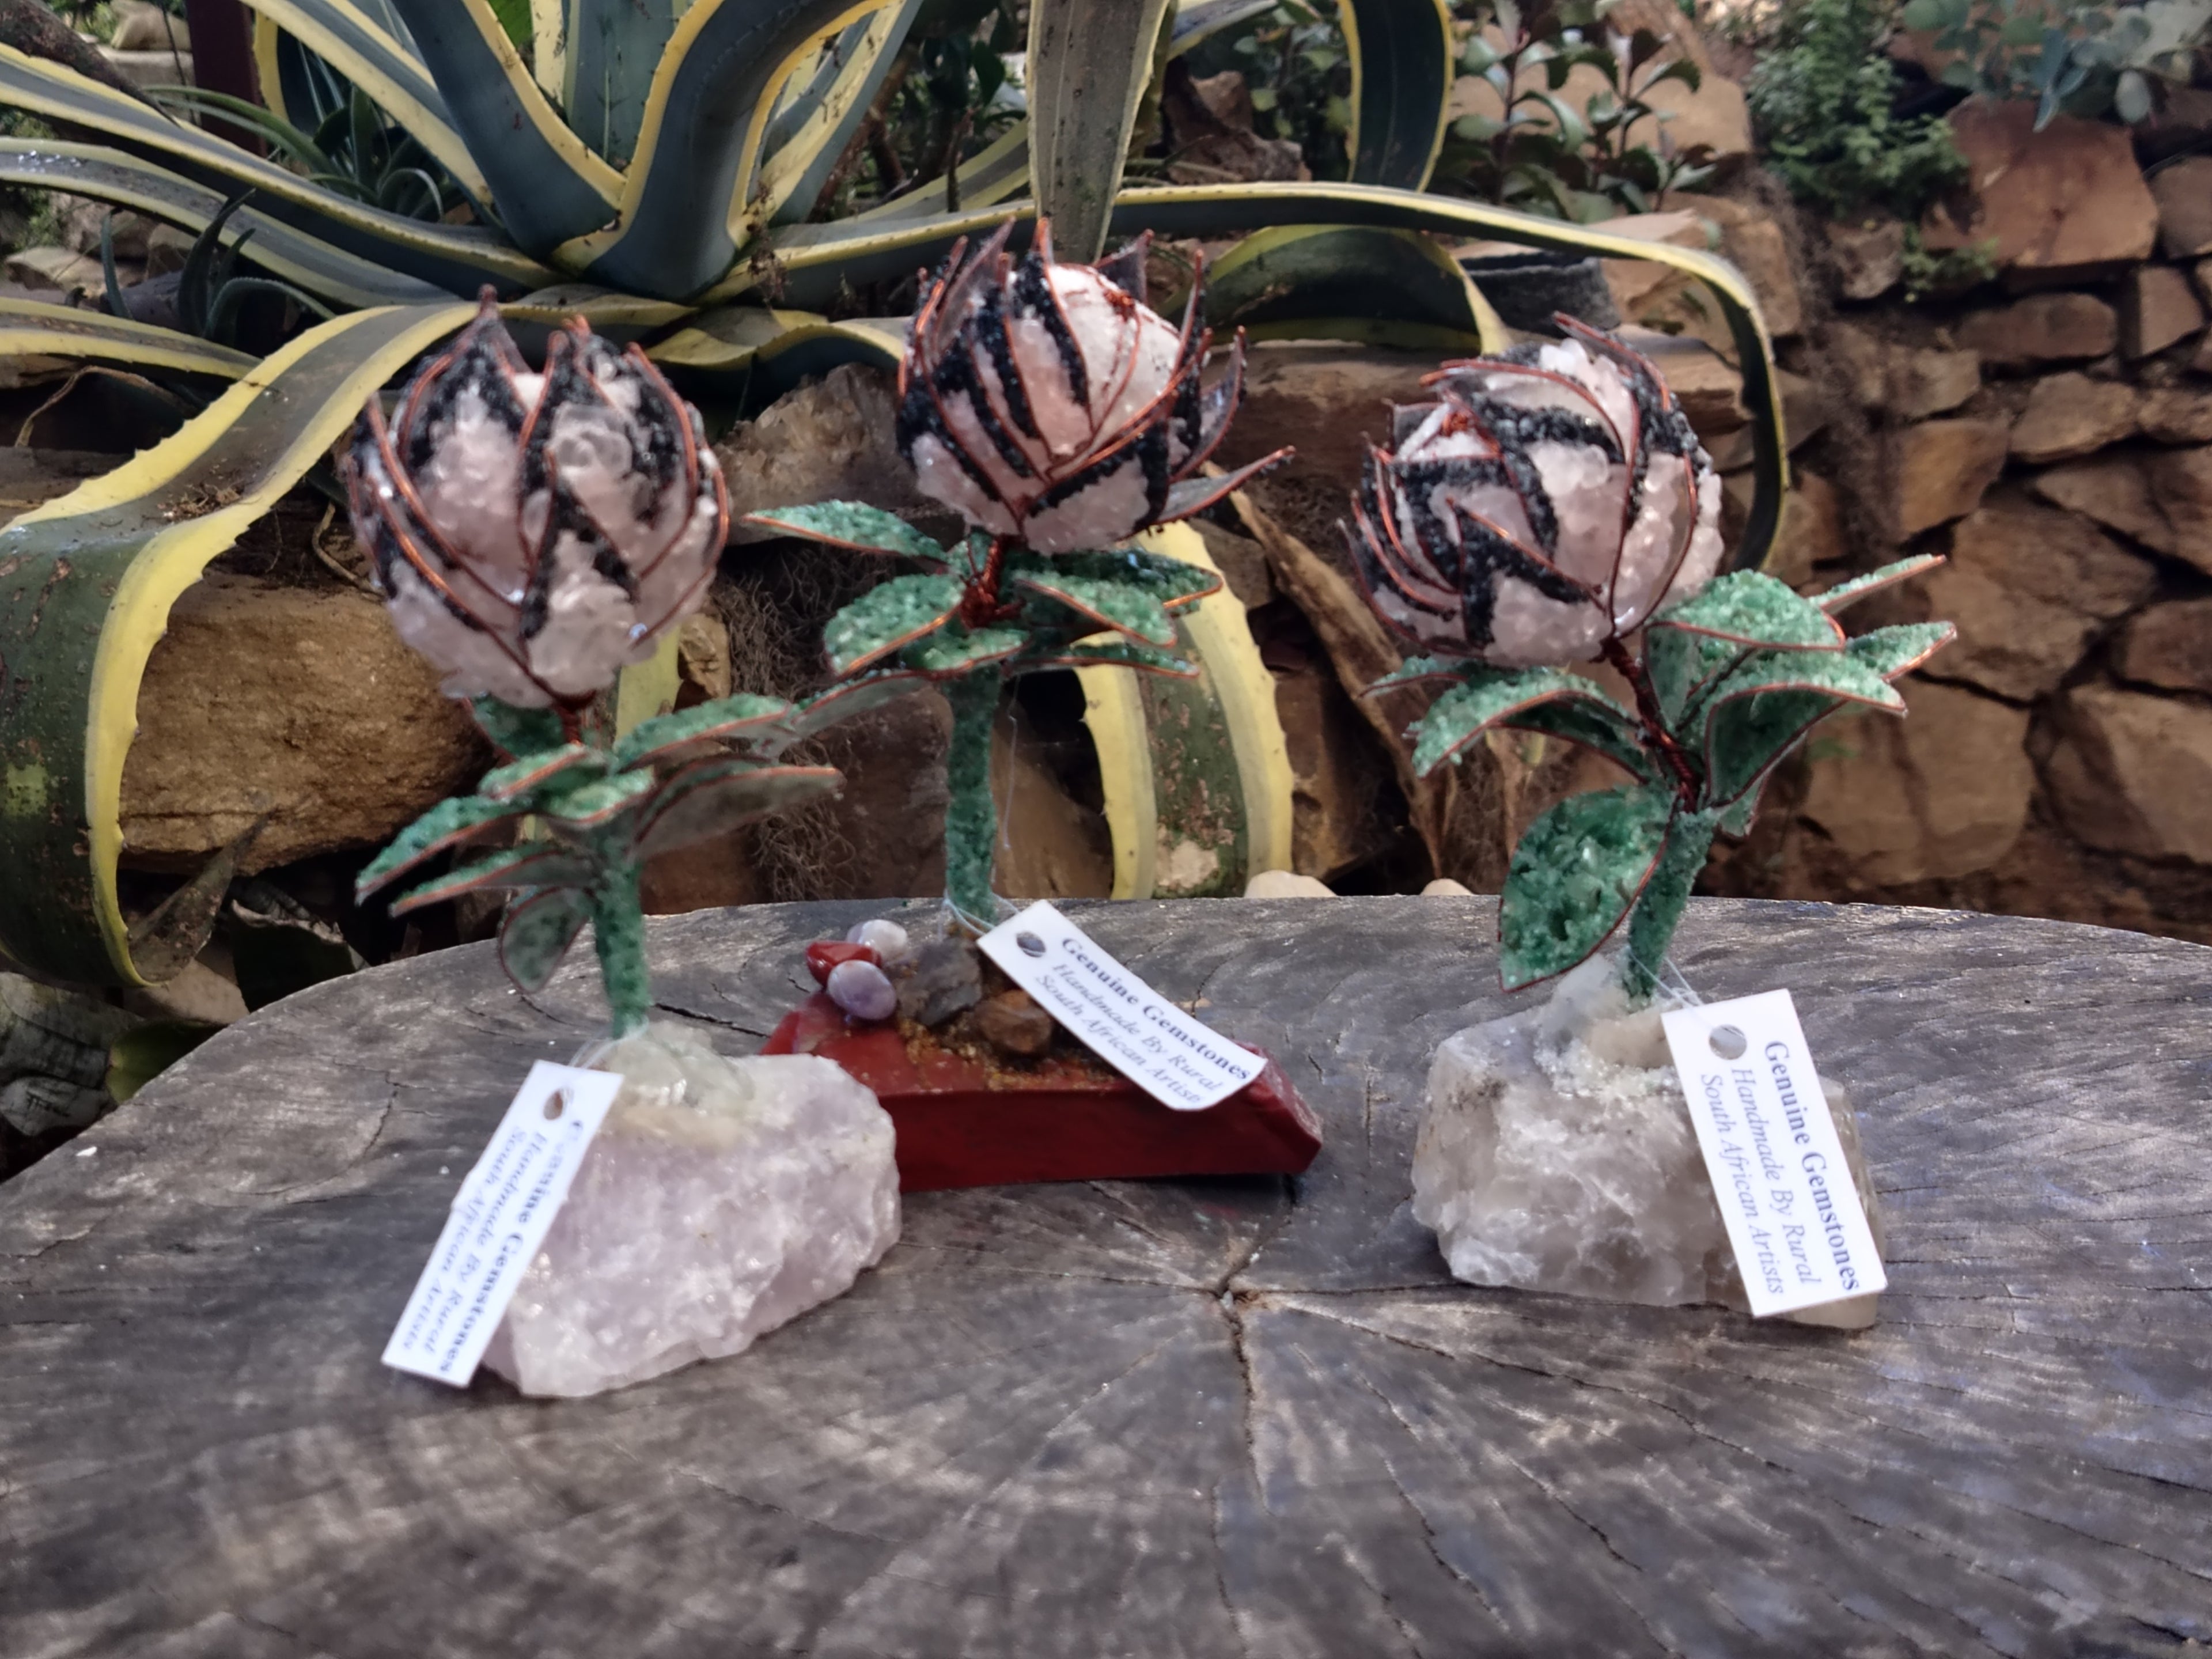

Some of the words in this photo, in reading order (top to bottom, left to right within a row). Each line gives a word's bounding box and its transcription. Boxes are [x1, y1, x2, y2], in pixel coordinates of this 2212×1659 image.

[1036, 974, 1082, 1017] South
[1081, 1017, 1147, 1066] African
[1051, 963, 1141, 1035] Handmade
[1142, 1035, 1168, 1054] By
[1168, 1054, 1223, 1091] Rural
[1062, 938, 1139, 1005] Genuine
[1143, 1005, 1251, 1081] Gemstones
[477, 1132, 547, 1247] Handmade
[485, 1127, 527, 1187] South
[517, 1120, 584, 1224] Gnuine
[1700, 1073, 1732, 1134] South
[1719, 1138, 1760, 1219] African
[1749, 1224, 1784, 1296] Artists
[1730, 1067, 1785, 1181] Handmade
[1769, 1188, 1794, 1217] By
[1782, 1224, 1821, 1286] Rural
[1764, 1040, 1811, 1146] Genuine
[1802, 1151, 1859, 1291] Gemstones
[424, 1290, 463, 1355] Rural
[440, 1233, 524, 1373] Gemstones
[460, 1253, 481, 1283] By
